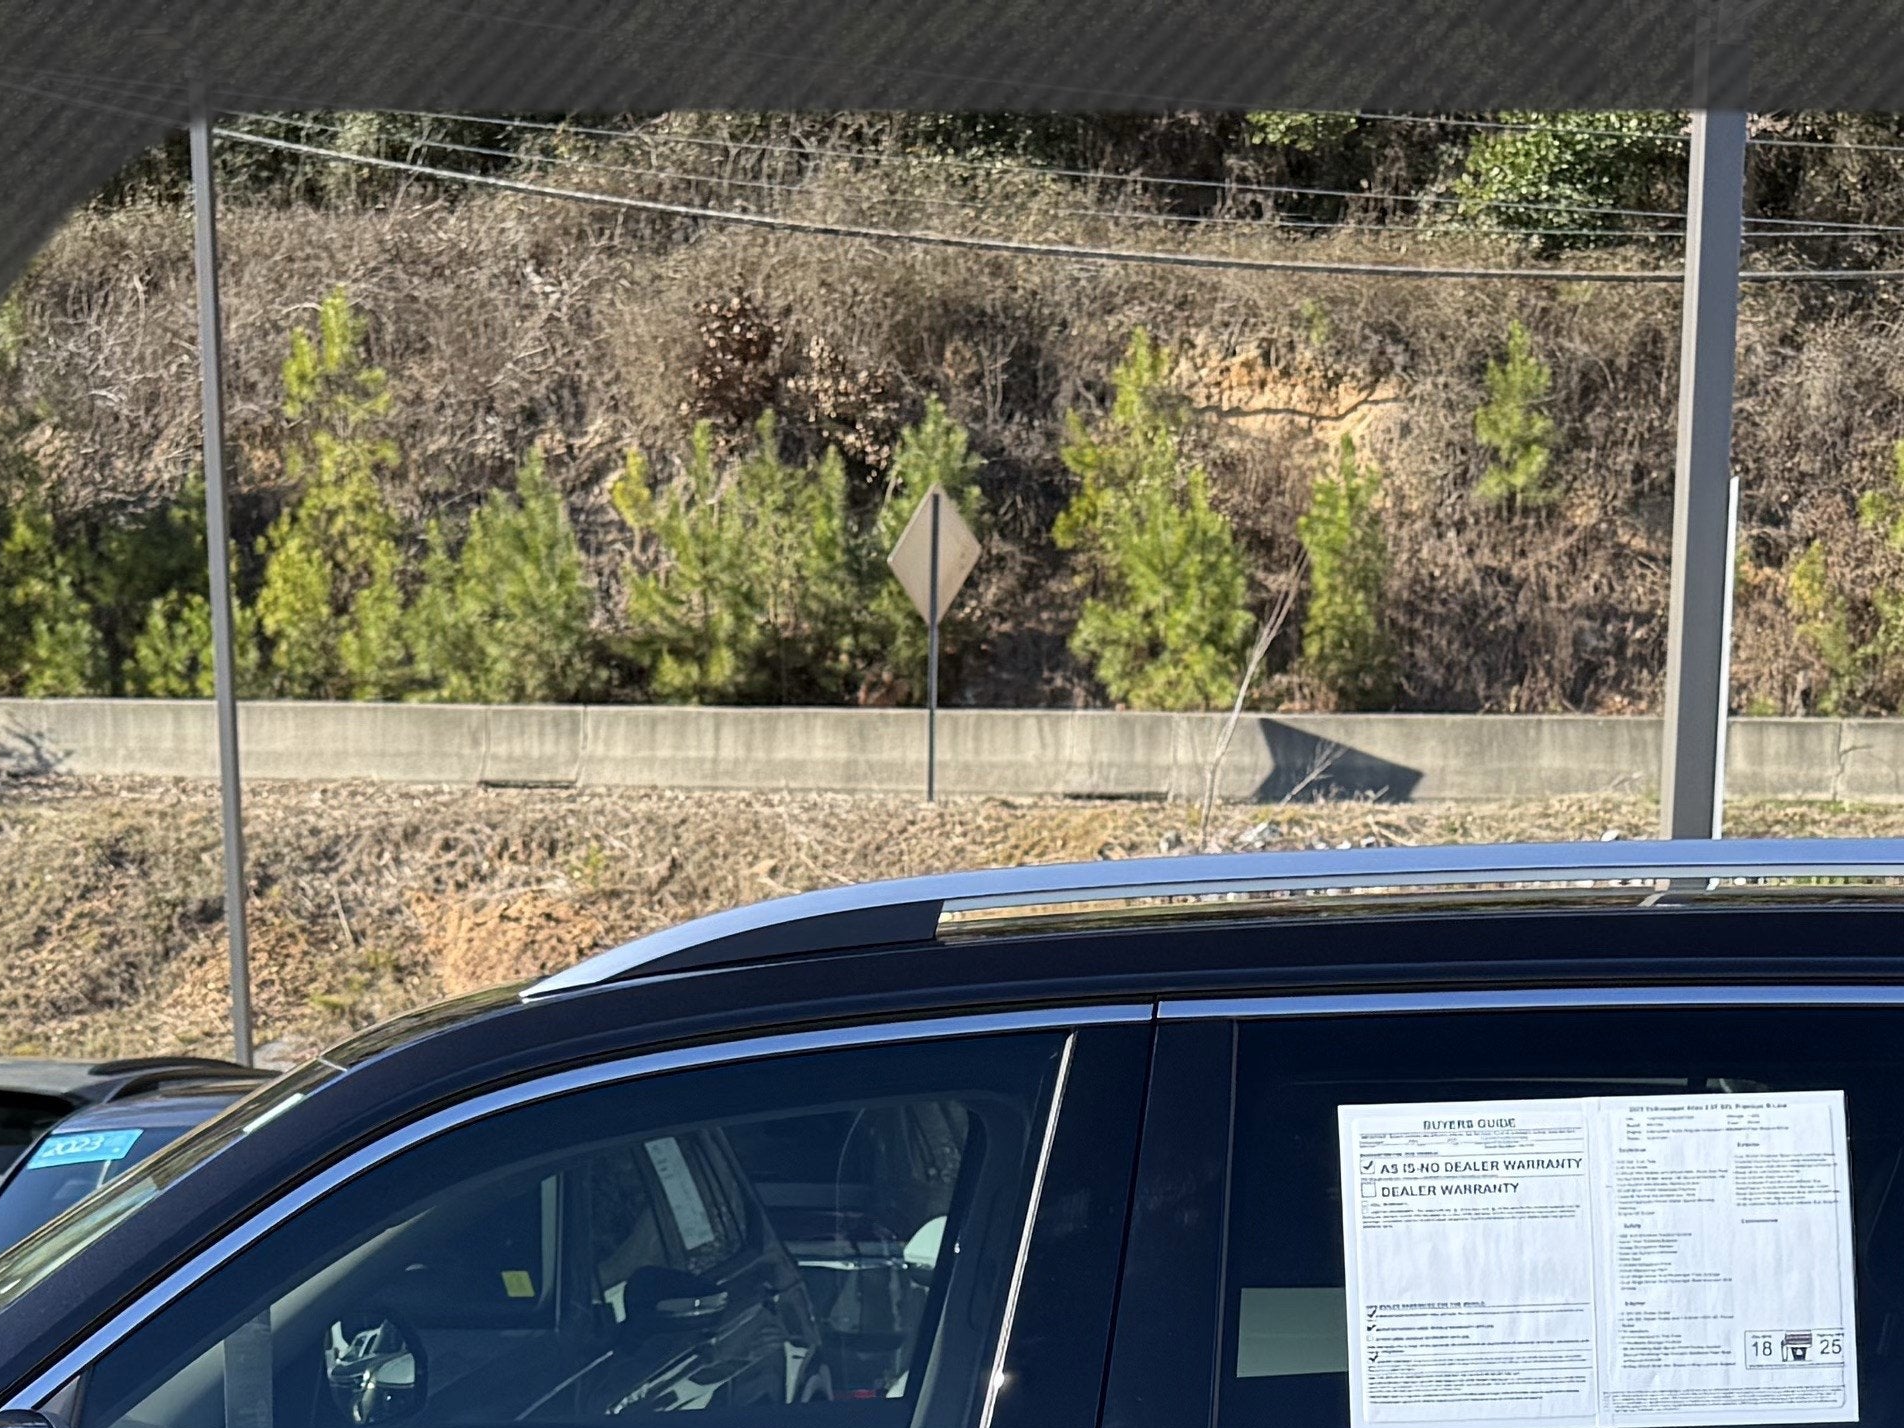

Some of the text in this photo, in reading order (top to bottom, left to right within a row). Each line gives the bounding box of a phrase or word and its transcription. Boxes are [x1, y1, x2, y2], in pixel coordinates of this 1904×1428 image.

[1423, 1118, 1516, 1130] BUYERS GUIDE
[1380, 1164, 1398, 1174] AS
[1444, 1160, 1500, 1172] DEALER
[1503, 1158, 1584, 1170] WARRANTY
[1381, 1183, 1520, 1197] DEALER WARRANTY
[1751, 1339, 1843, 1357] 18 25
